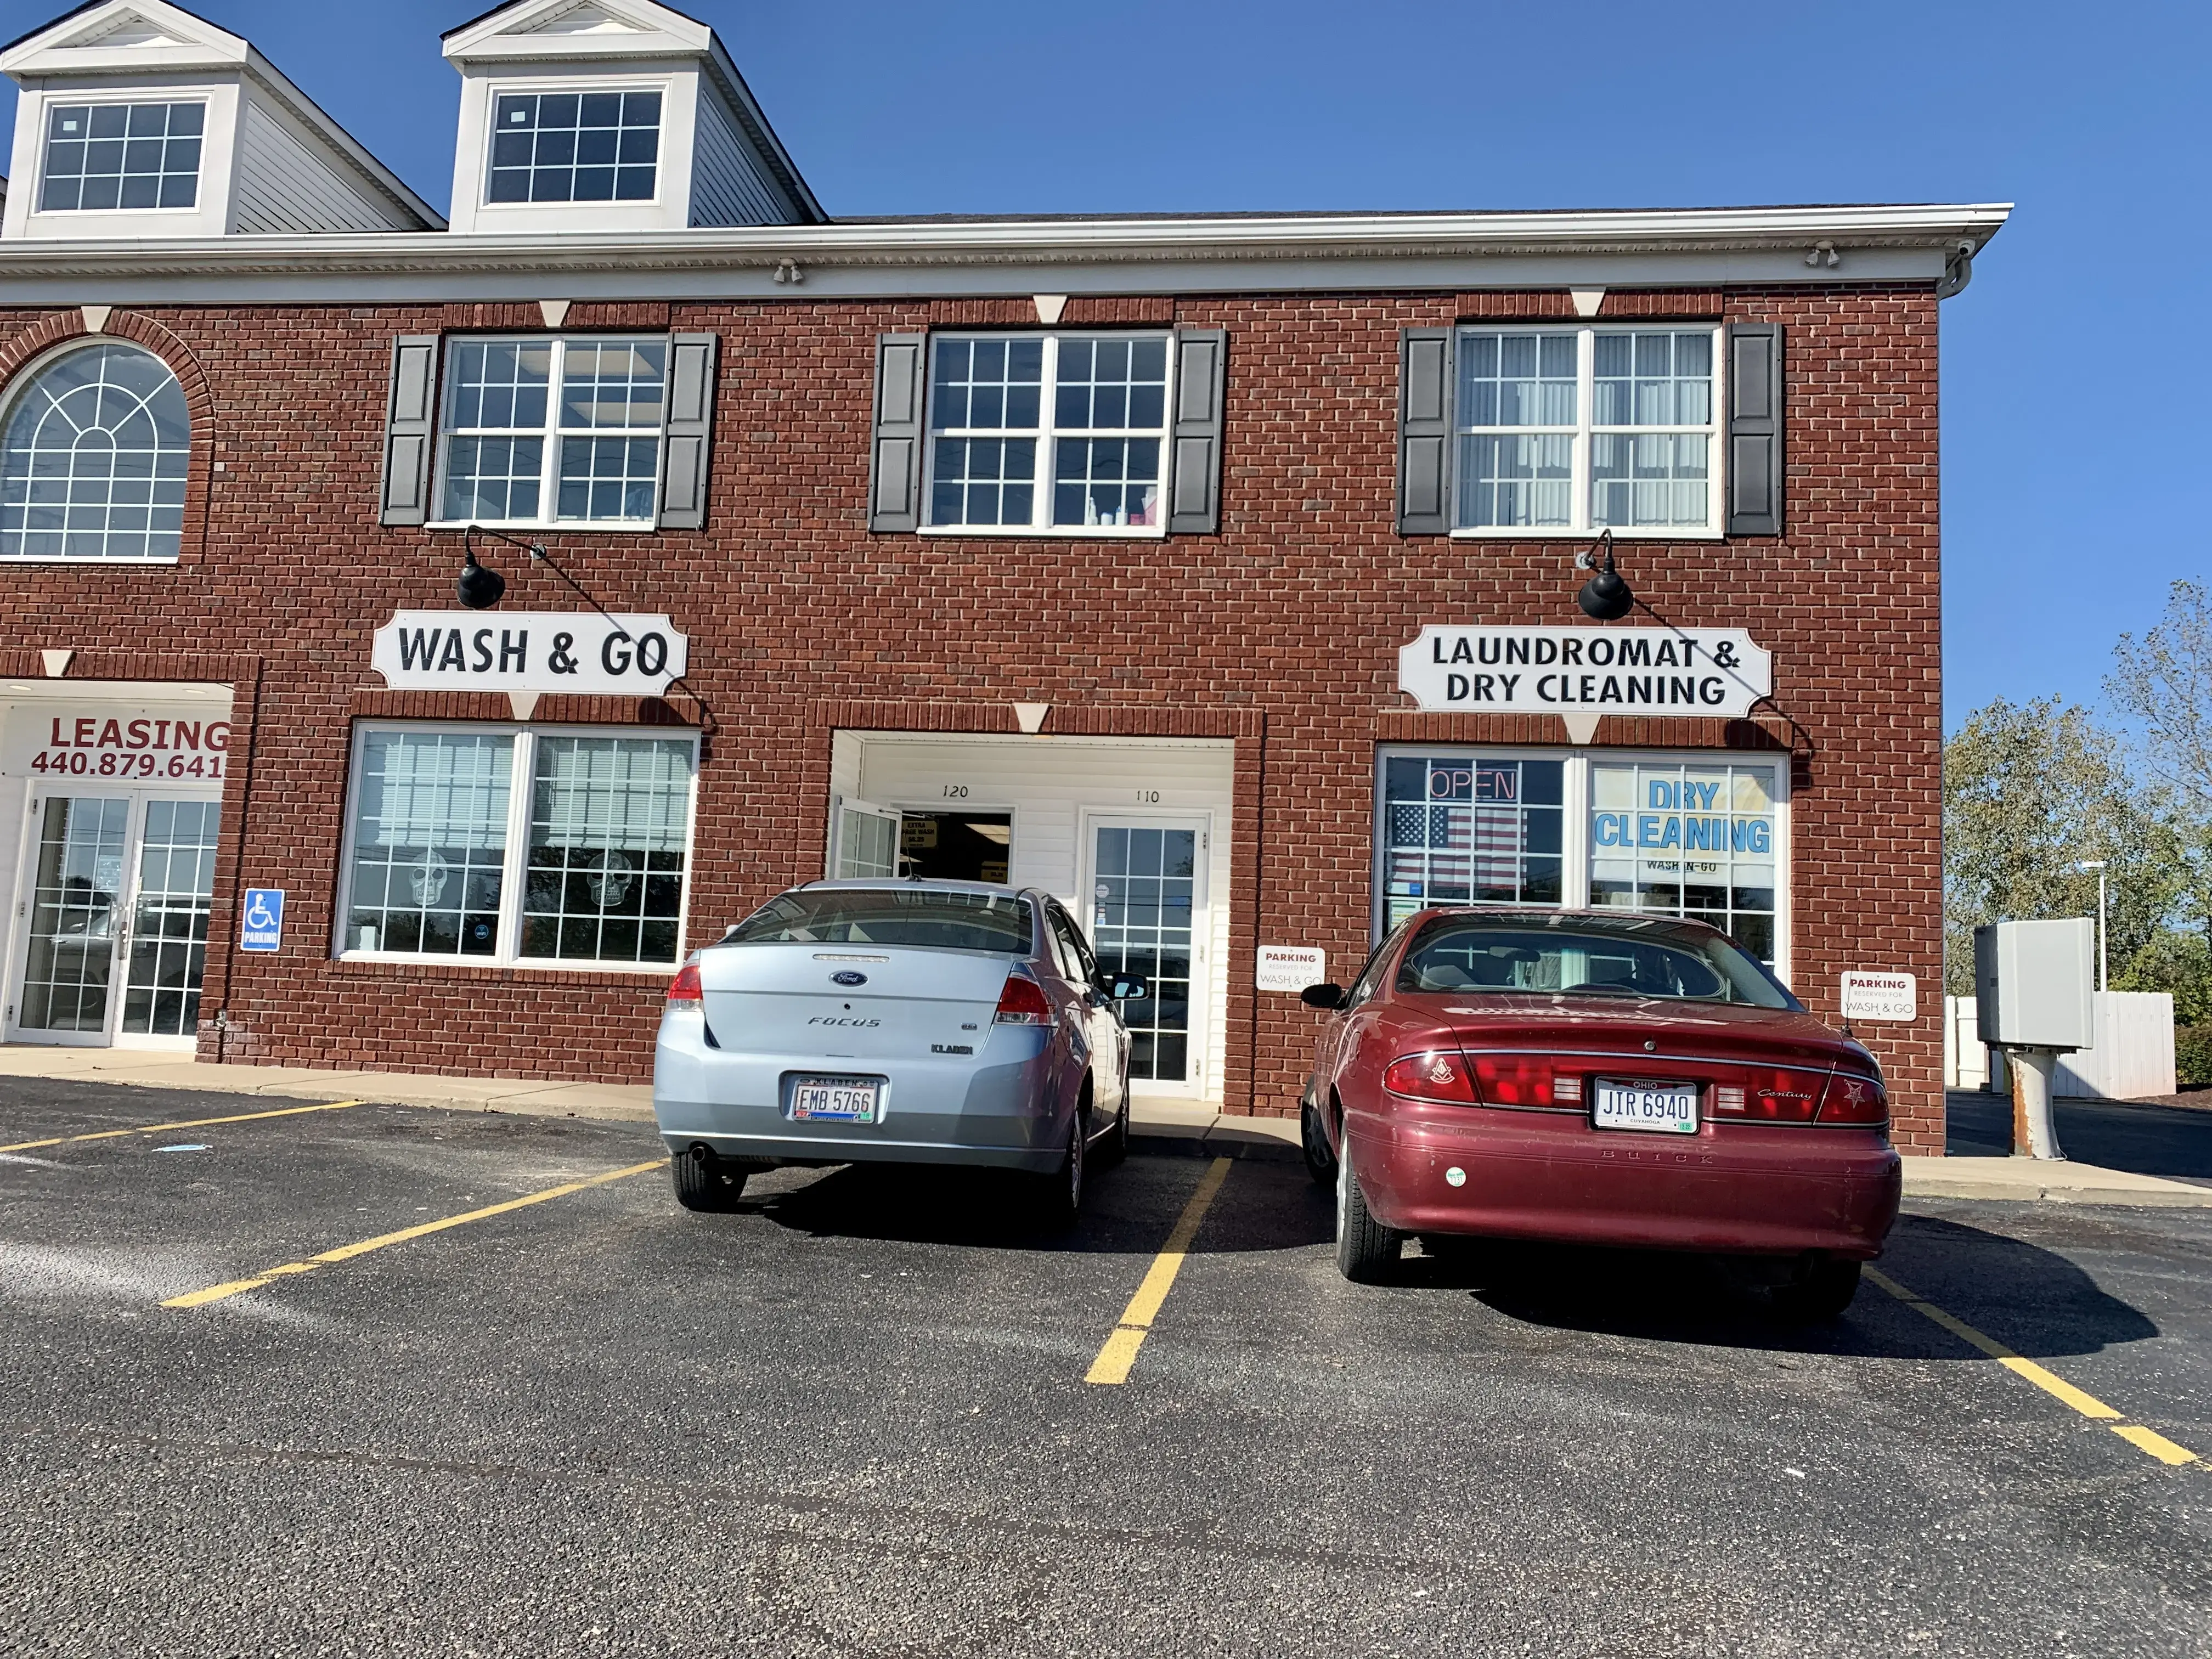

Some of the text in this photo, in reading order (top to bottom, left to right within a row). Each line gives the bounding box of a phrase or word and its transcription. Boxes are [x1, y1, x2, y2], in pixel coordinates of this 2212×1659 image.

[399, 628, 668, 676] WASH & GO
[1434, 637, 1741, 668] LAUNDROMAT &
[1447, 674, 1726, 705] DRY CLEANING
[50, 718, 232, 751] LEASING
[31, 752, 222, 778] 440.879.641
[943, 785, 968, 798] 120
[1430, 771, 1514, 799] OPEN
[1137, 791, 1159, 803] 110
[1649, 780, 1720, 810] DRY
[1595, 814, 1770, 853] CLEANING
[244, 932, 277, 944] PARKING
[1266, 953, 1316, 962] PARKING
[838, 973, 859, 982] Ford
[1260, 974, 1322, 985] WASH & GO
[1850, 979, 1906, 989] PARKING
[1845, 1001, 1914, 1013] WASH & GO
[808, 1017, 881, 1027] FOCUS
[1633, 1081, 1657, 1090] OHIO
[1757, 1088, 1812, 1101] Century
[799, 1090, 870, 1113] EMB 5766
[1603, 1091, 1688, 1120] JIR 6940
[1601, 1150, 1713, 1164] BUICK
